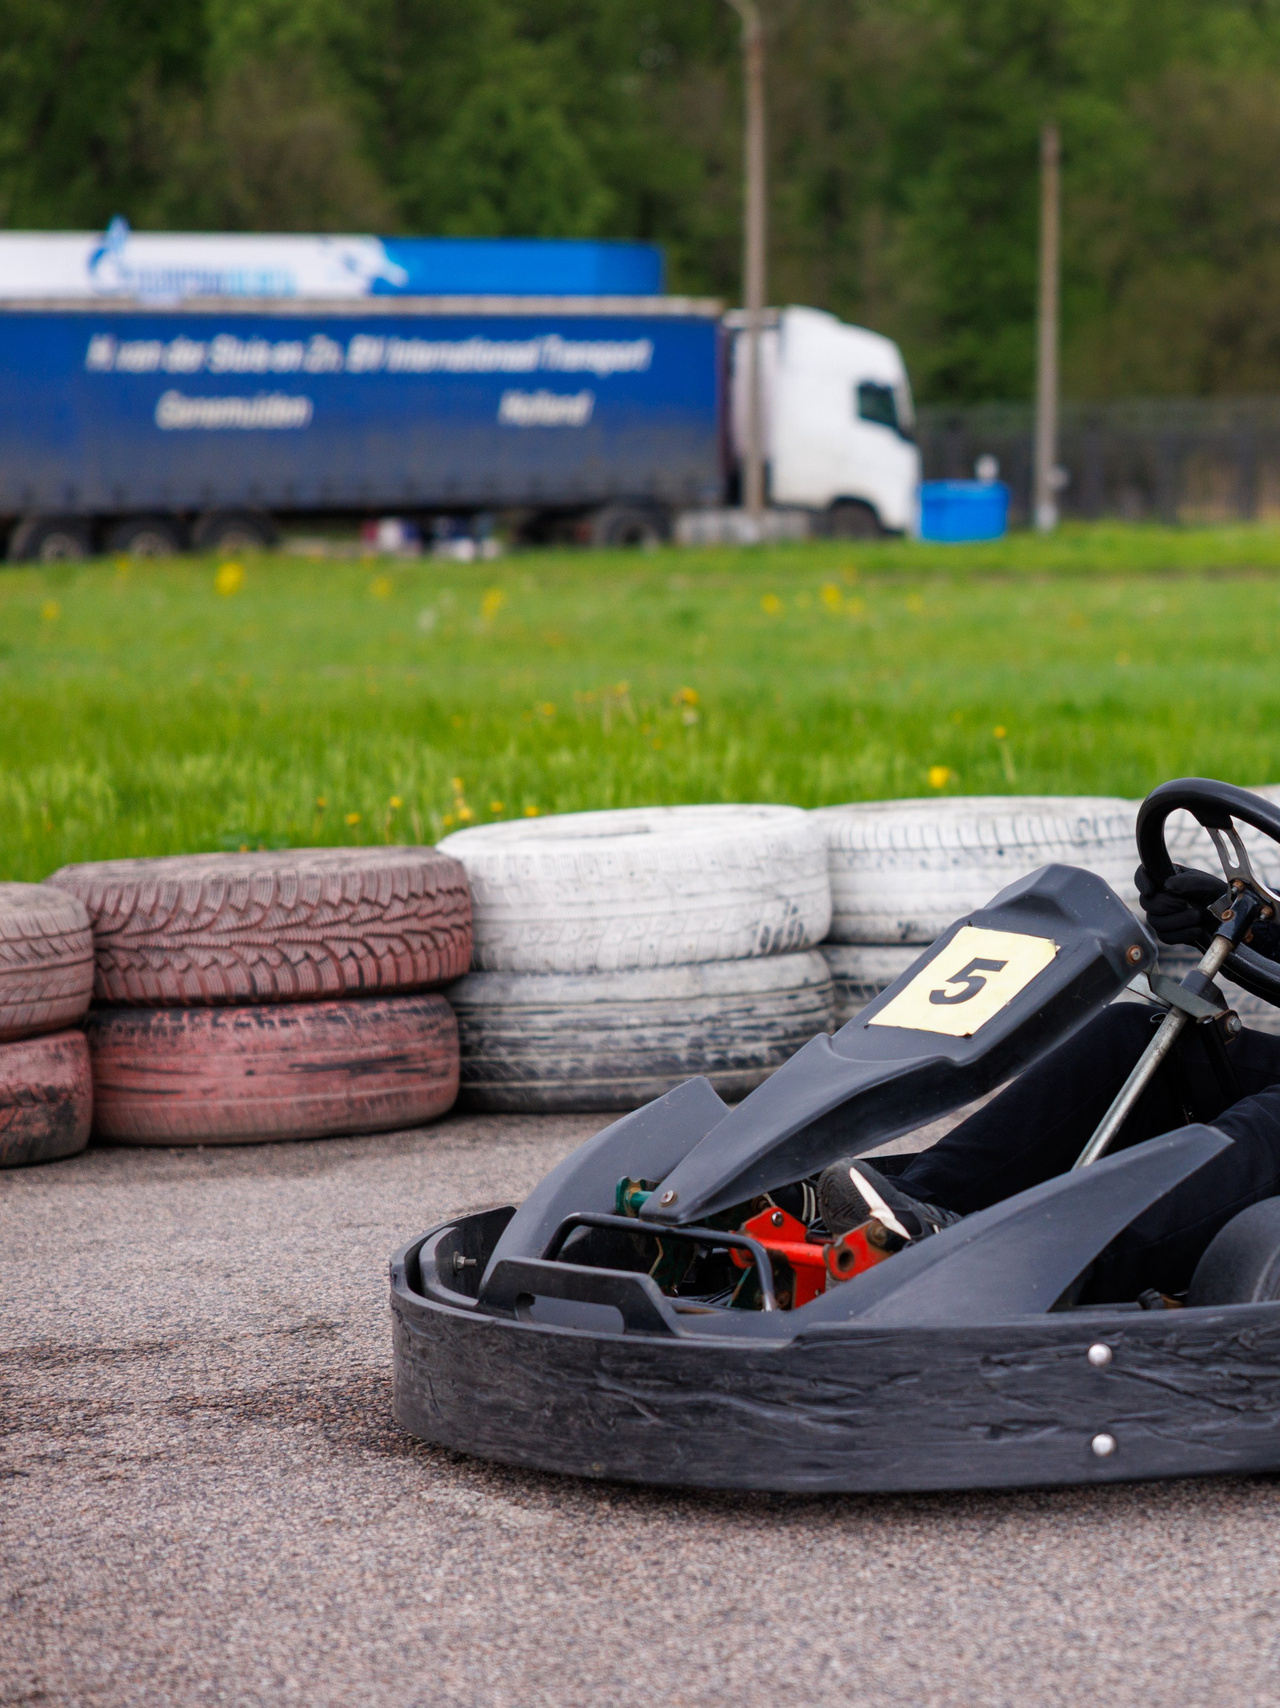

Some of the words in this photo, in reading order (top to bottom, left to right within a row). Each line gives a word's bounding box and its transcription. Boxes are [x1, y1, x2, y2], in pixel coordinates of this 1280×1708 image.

[386, 336, 540, 374] International
[541, 334, 653, 377] Transport
[929, 957, 1009, 1005] 5
